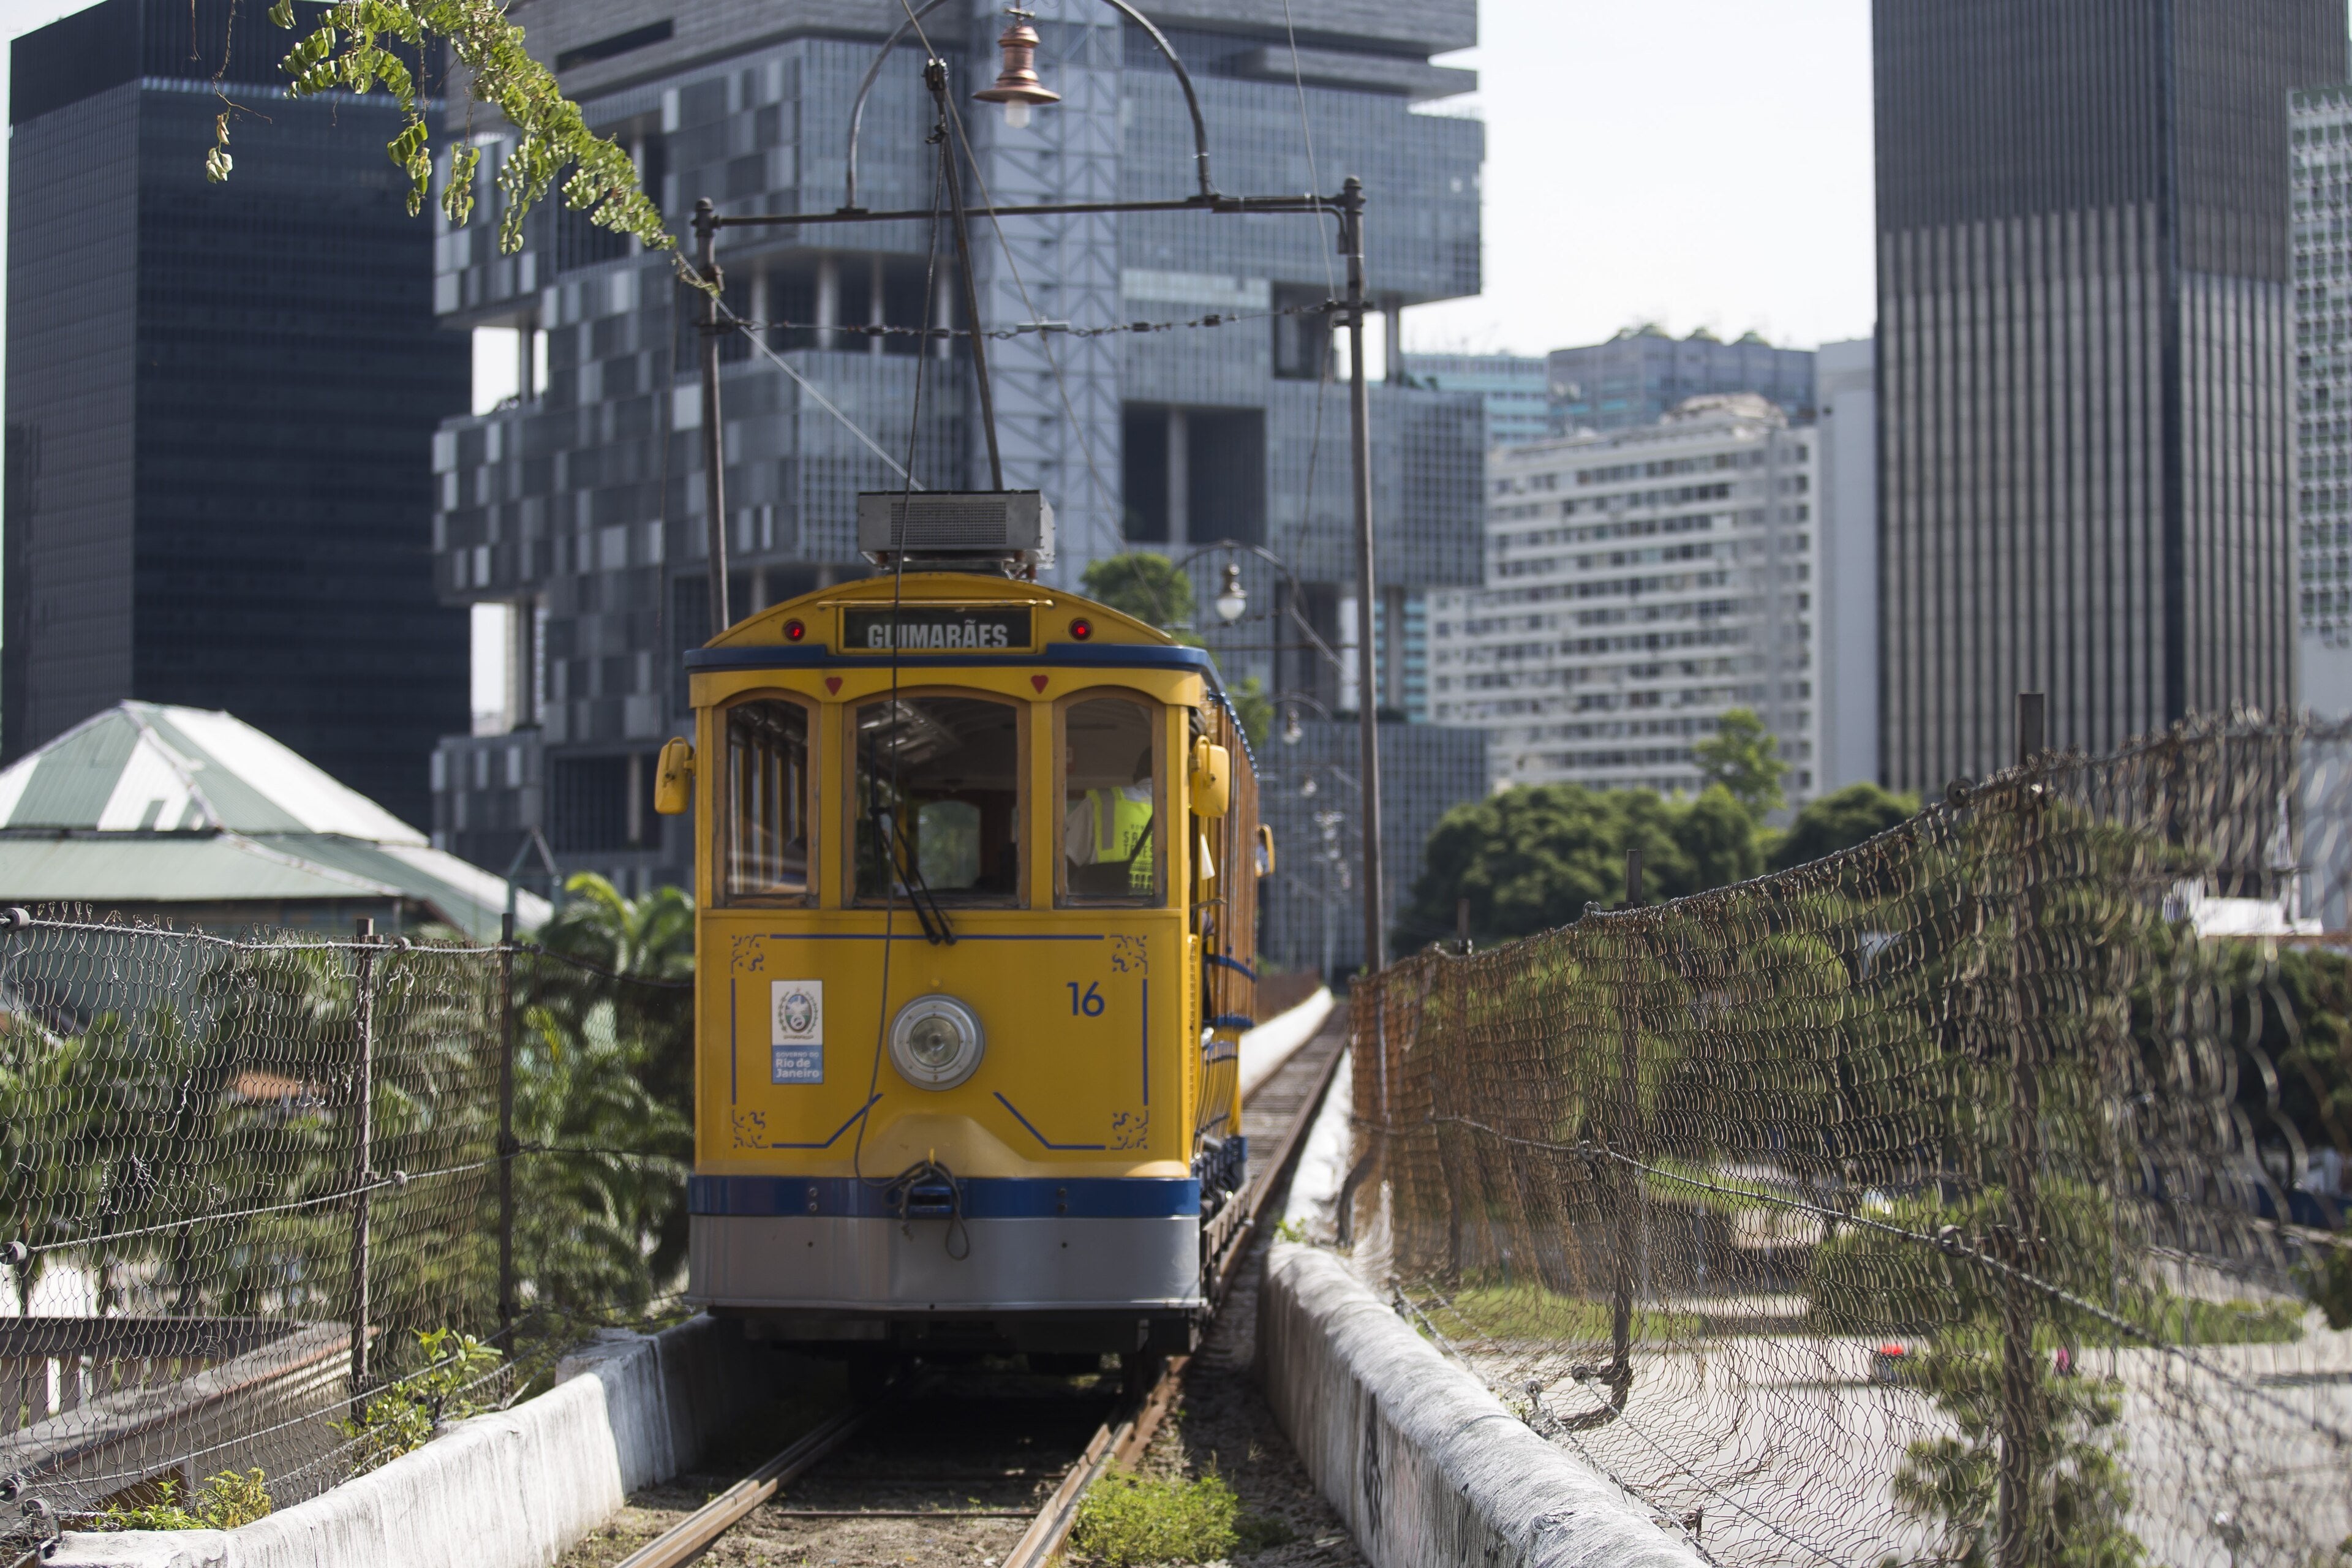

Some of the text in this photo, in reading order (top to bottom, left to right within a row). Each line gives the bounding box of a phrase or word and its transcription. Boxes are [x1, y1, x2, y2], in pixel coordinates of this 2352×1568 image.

[867, 619, 1008, 649] GUIMARÃES
[1066, 981, 1105, 1017] 16
[776, 1058, 811, 1068] Rio de
[776, 1068, 820, 1078] Janeiro
